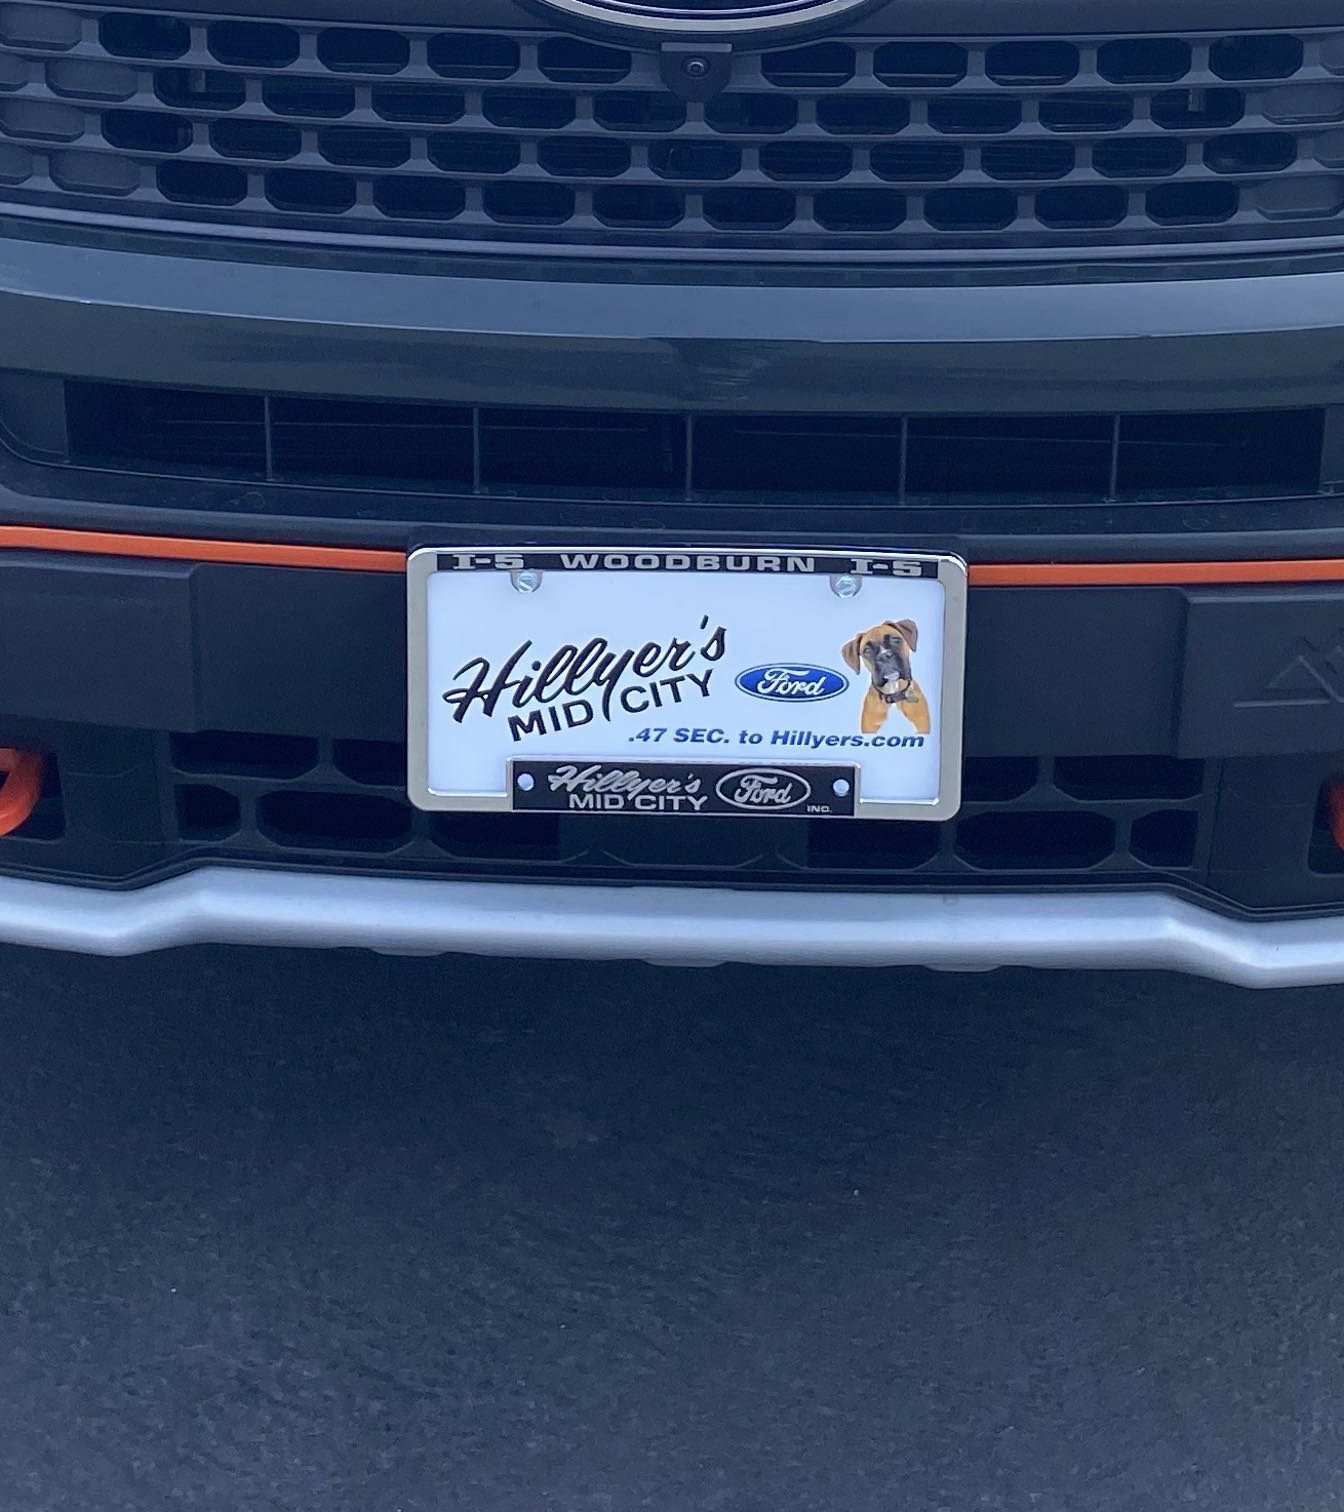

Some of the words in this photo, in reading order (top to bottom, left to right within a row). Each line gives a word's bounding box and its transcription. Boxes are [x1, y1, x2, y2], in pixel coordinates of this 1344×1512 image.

[453, 554, 524, 570] I-5
[560, 554, 815, 573] WOODBURN
[850, 559, 922, 577] I-5
[442, 614, 727, 723] Hillyer's
[757, 663, 826, 696] Ford
[508, 699, 594, 742] MID
[620, 669, 713, 713] CITY
[628, 727, 667, 743] .47
[672, 727, 730, 744] SEC.
[738, 729, 763, 745] to
[770, 730, 925, 749] Hillyers.com
[548, 764, 702, 800] Hillyer's
[569, 794, 625, 809] MID
[634, 794, 708, 811] CITY
